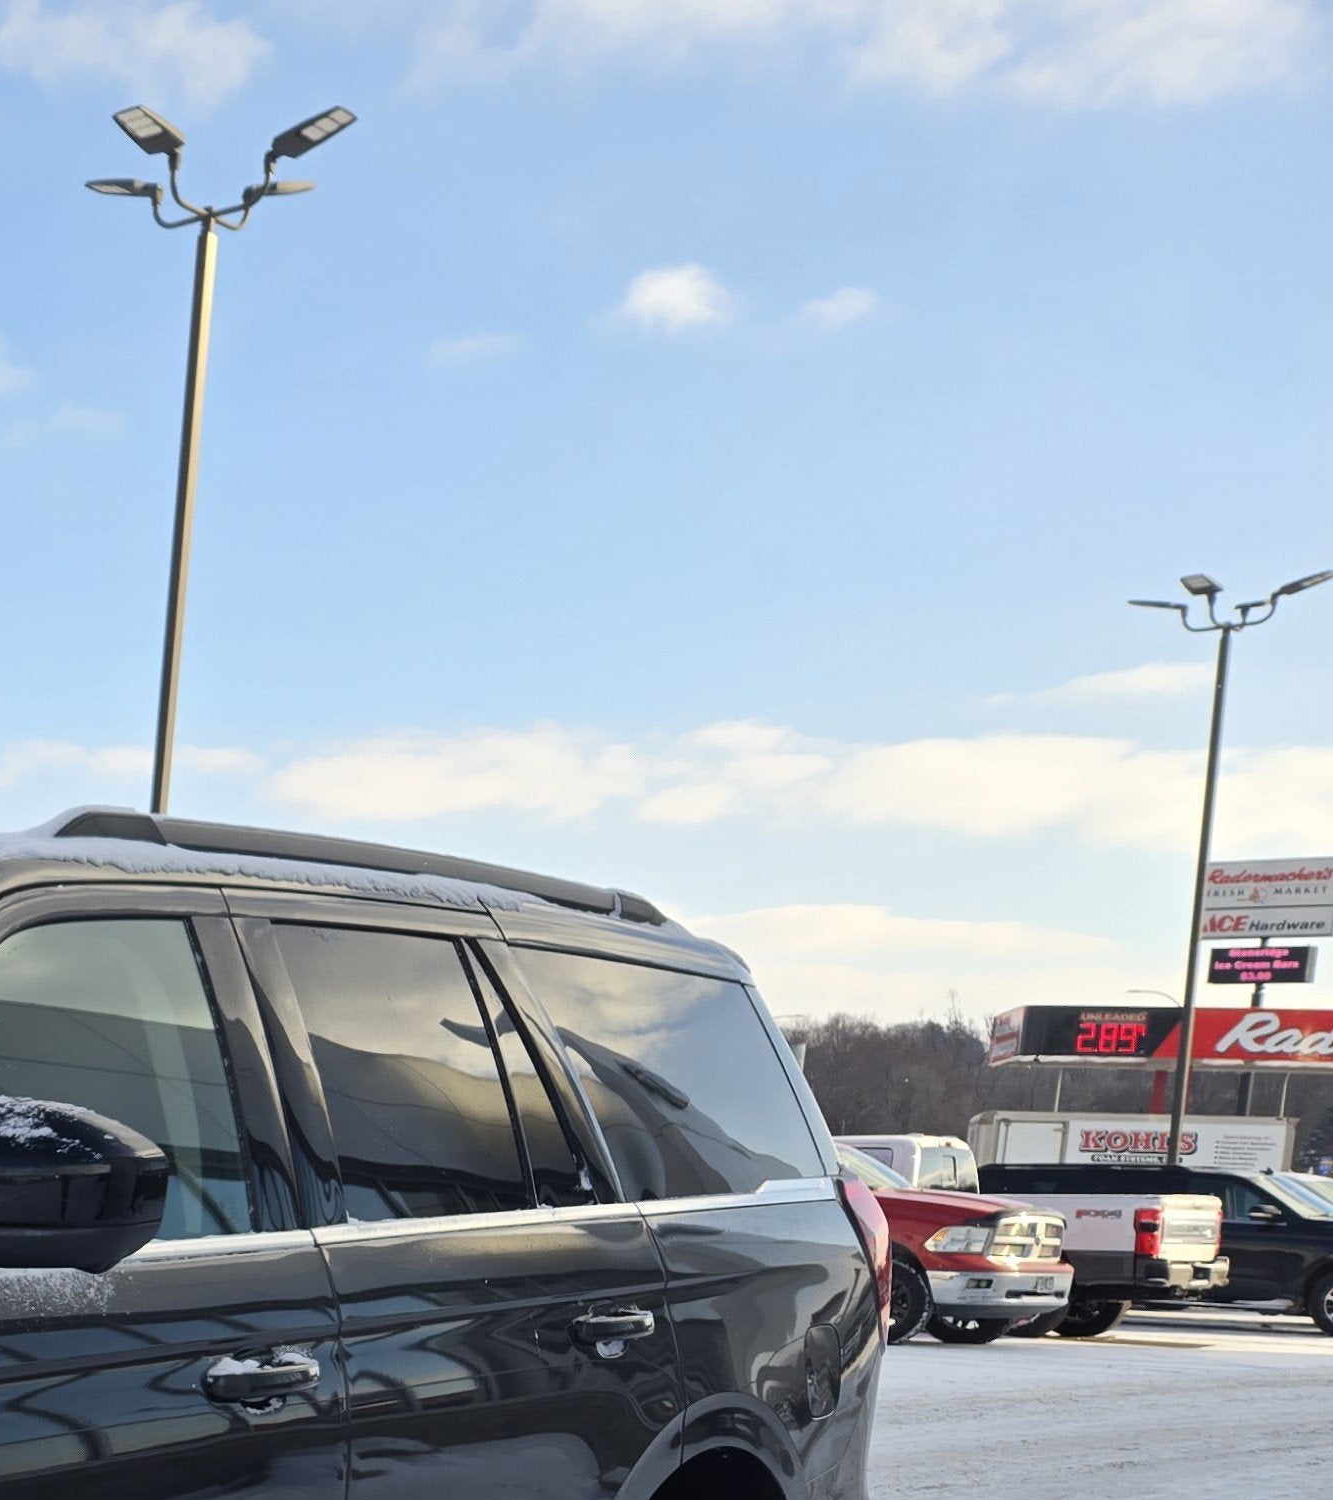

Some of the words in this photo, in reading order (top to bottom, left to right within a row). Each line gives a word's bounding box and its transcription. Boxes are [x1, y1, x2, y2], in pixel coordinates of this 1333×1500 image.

[1274, 885, 1328, 895] MARKET
[1202, 914, 1249, 932] ACE
[1248, 919, 1326, 931] Hardware
[1080, 1012, 1147, 1021] UNLEADED
